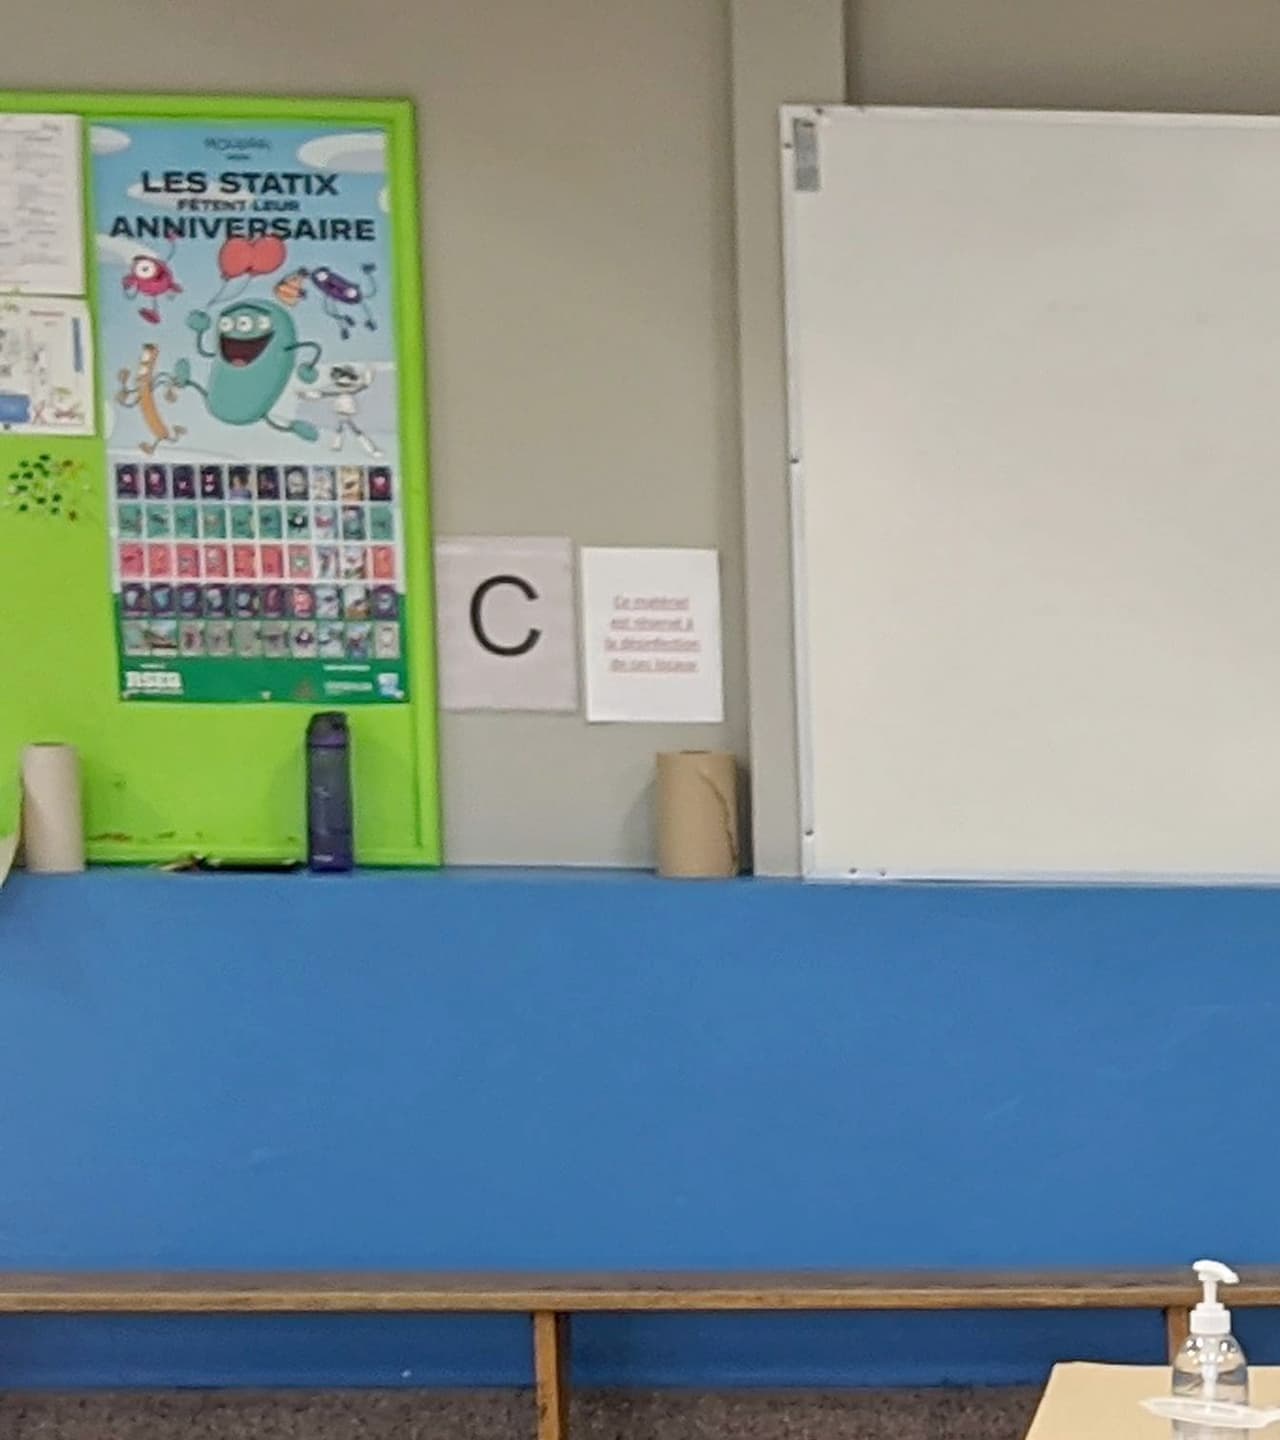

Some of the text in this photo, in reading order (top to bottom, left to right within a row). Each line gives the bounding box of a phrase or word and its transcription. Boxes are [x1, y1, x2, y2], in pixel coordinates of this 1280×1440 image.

[142, 171, 340, 196] LES STATIX
[253, 201, 301, 212] LEUR
[110, 215, 376, 241] ANNIVERSAIRE
[469, 574, 542, 657] C
